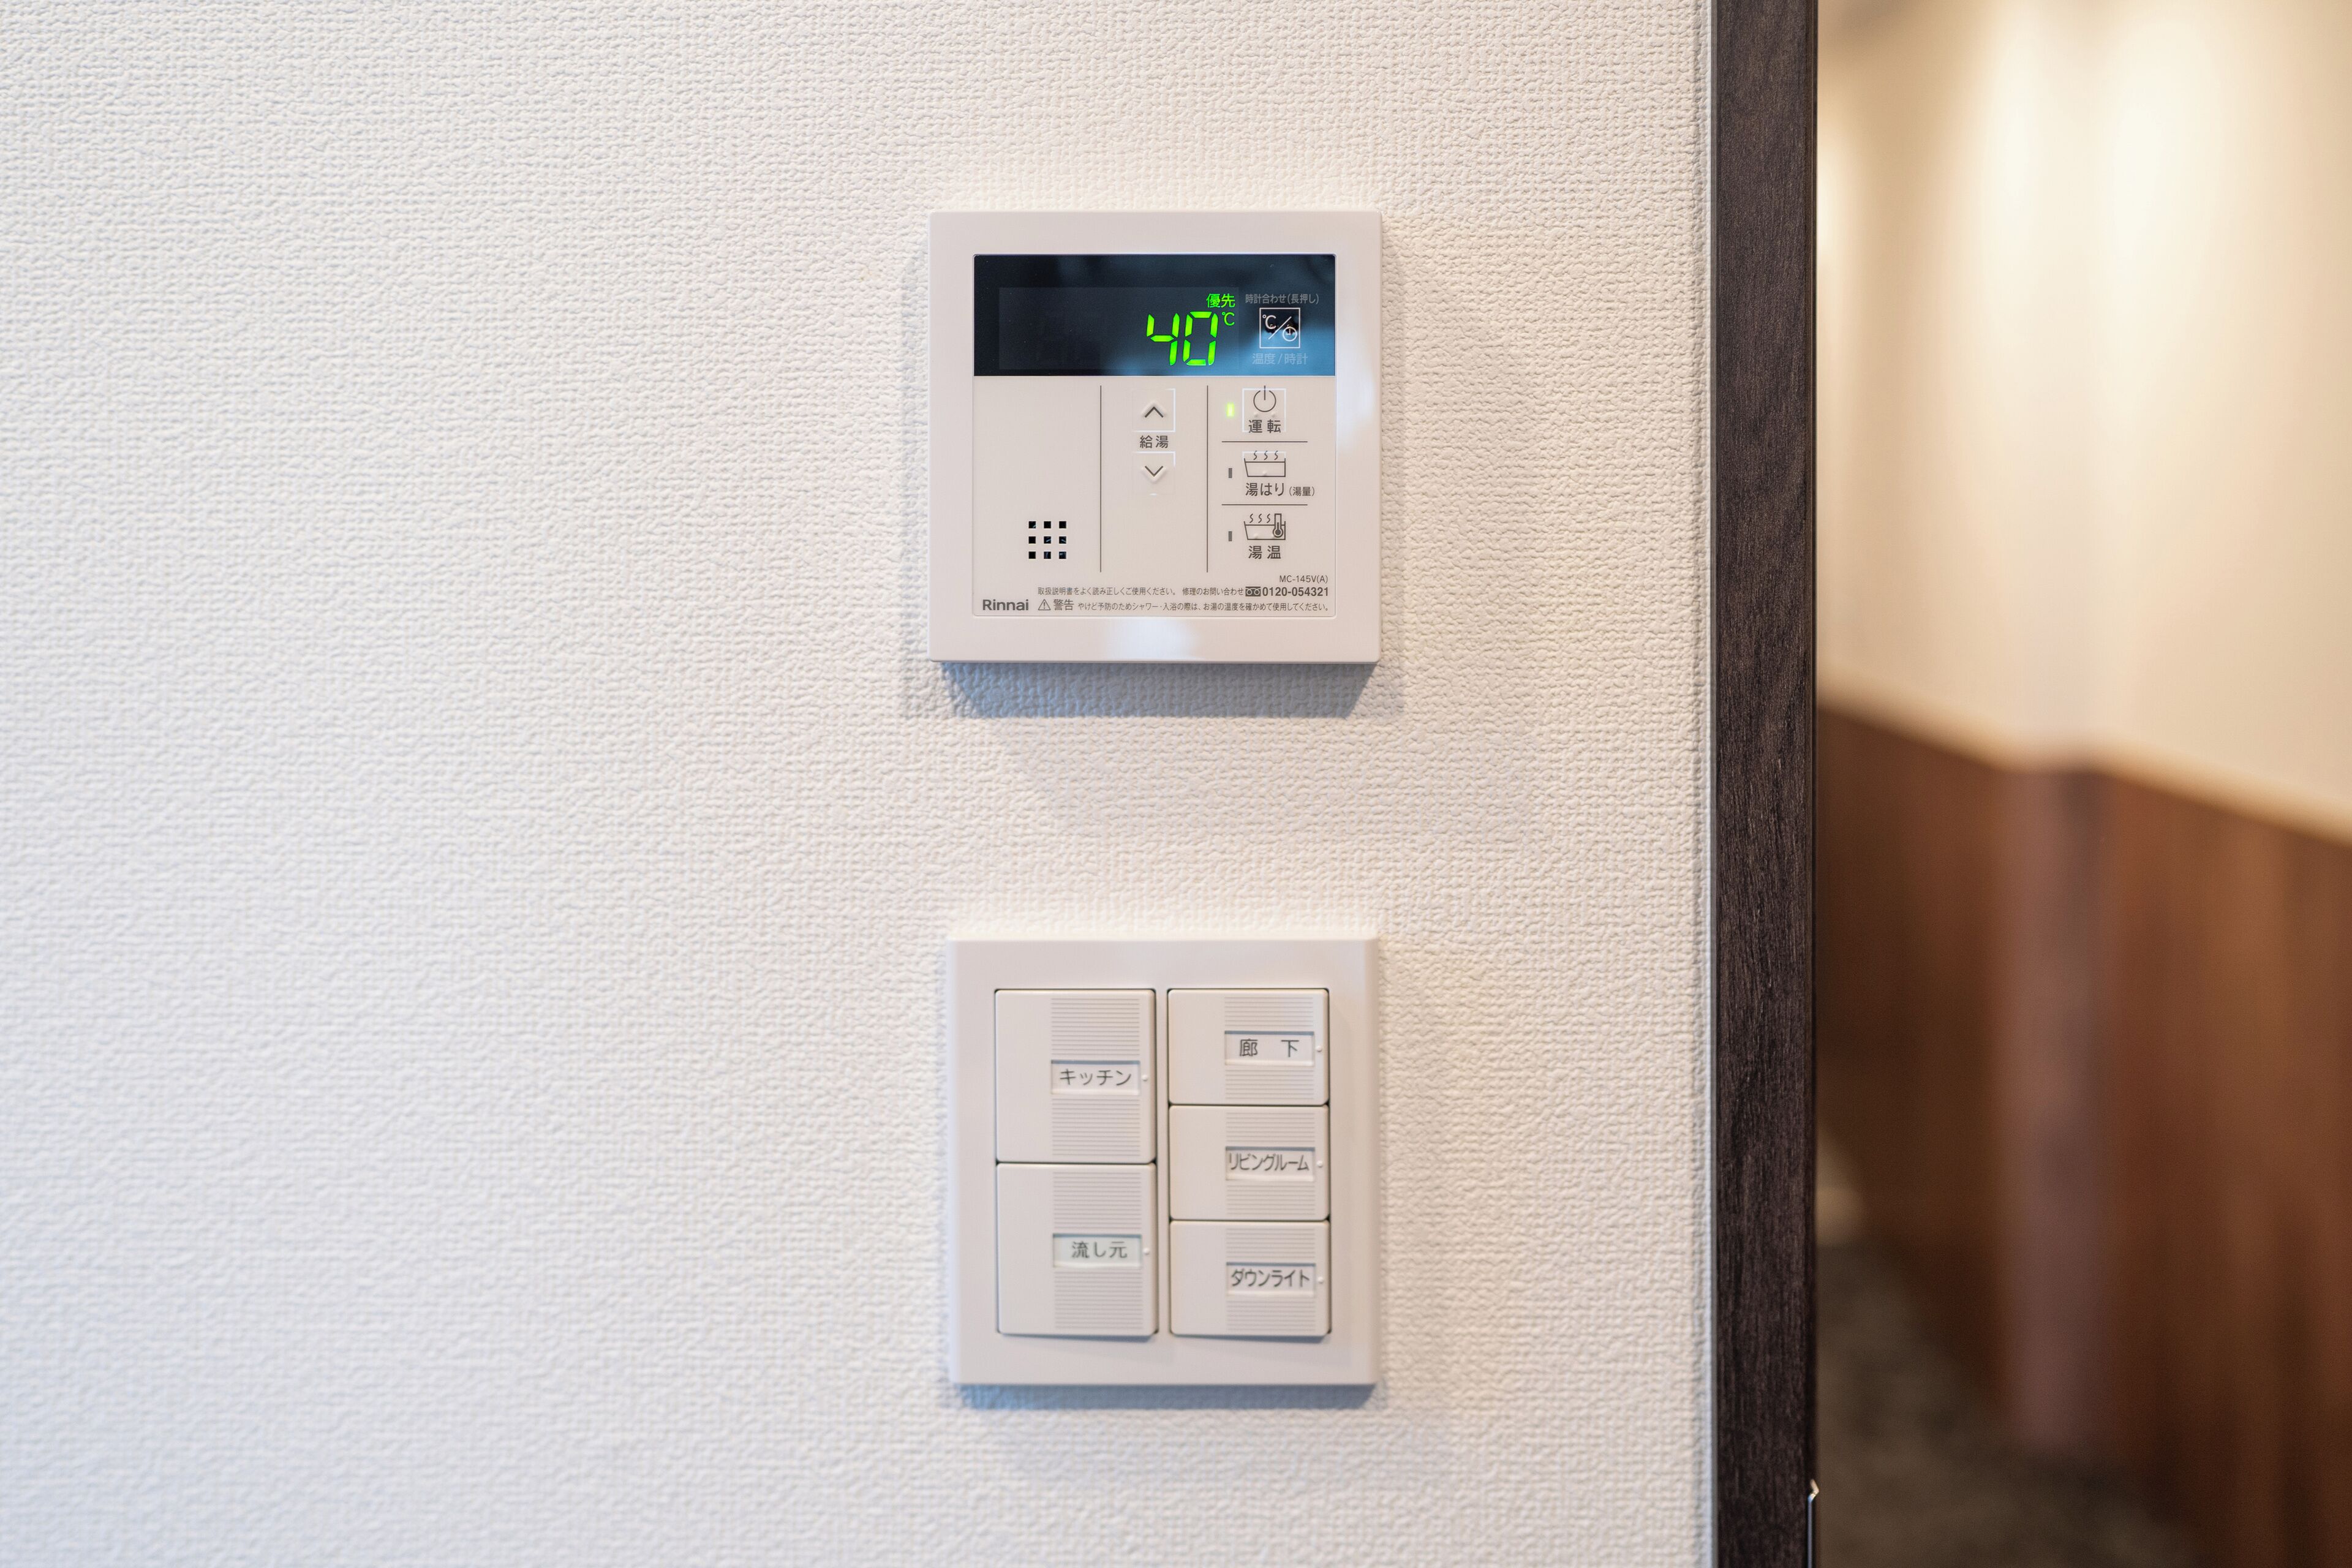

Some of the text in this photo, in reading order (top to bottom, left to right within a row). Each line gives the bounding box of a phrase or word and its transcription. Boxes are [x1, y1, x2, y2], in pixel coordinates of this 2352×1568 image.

[1206, 293, 1235, 308] 優先
[1146, 311, 1218, 366] 40
[1248, 419, 1281, 433] 運転
[1139, 435, 1169, 448] 給湯
[1248, 545, 1281, 559] 湯温
[1279, 575, 1329, 584] MC-145V(A)
[1262, 587, 1329, 597] 0120-054321
[982, 599, 1029, 611] Rinnai
[1053, 599, 1074, 611] 警告
[1060, 1069, 1131, 1086] キッチン
[1229, 1154, 1309, 1171] リビングルーム
[1071, 1241, 1128, 1259] 流し元
[1231, 1268, 1310, 1287] ダウンライト
